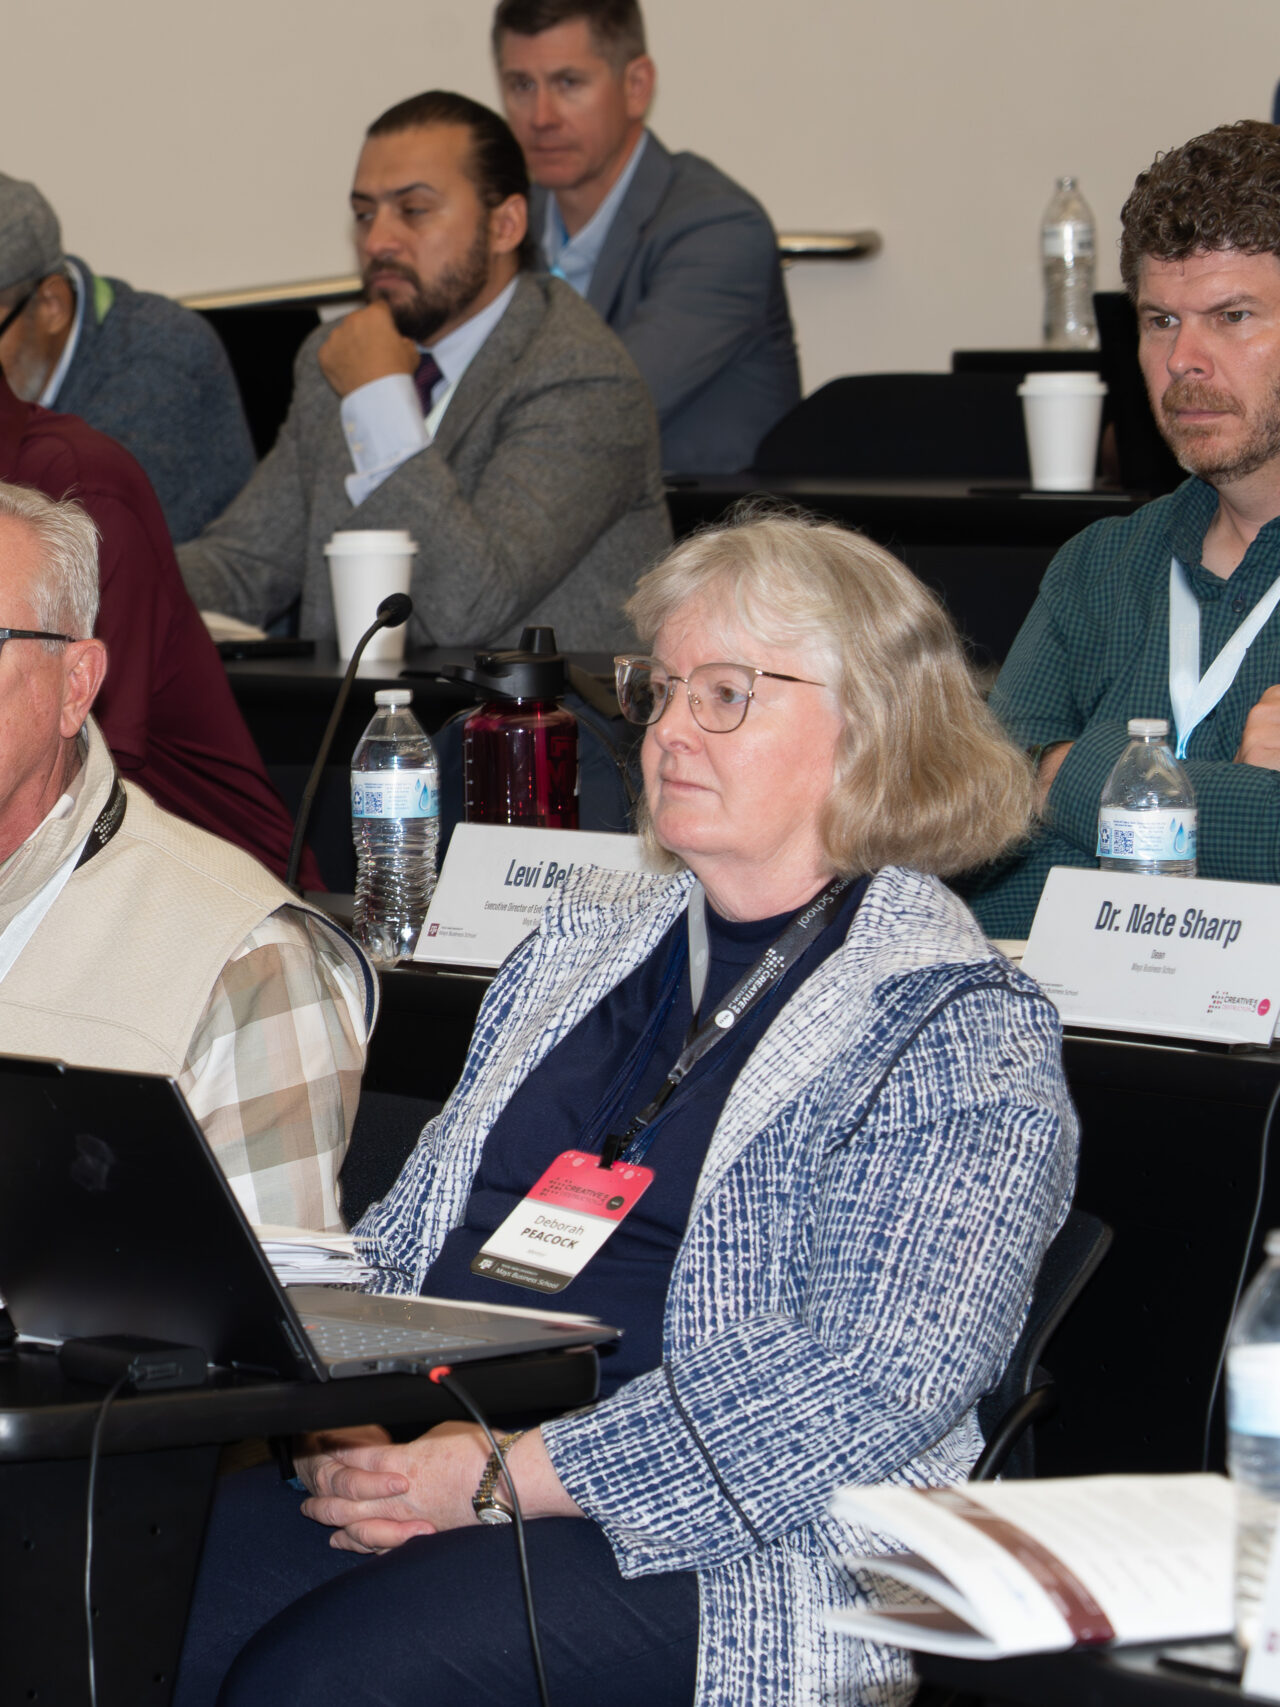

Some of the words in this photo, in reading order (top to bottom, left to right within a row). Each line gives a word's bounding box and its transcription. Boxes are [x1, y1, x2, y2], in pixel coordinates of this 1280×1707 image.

[504, 858, 544, 888] Levi
[542, 861, 574, 888] Bel
[830, 879, 851, 896] ess
[484, 900, 508, 912] Executive
[508, 902, 528, 913] Director
[527, 904, 534, 913] of
[534, 905, 544, 914] Ent
[796, 893, 835, 929] School
[1094, 900, 1121, 931] Dr.
[1125, 903, 1176, 936] Nate
[1179, 908, 1242, 949] Sharp
[738, 969, 771, 1009] CREATIVE
[564, 1182, 605, 1199] CREATIVE
[533, 1215, 585, 1236] Deborah
[521, 1227, 579, 1249] PEACOCK
